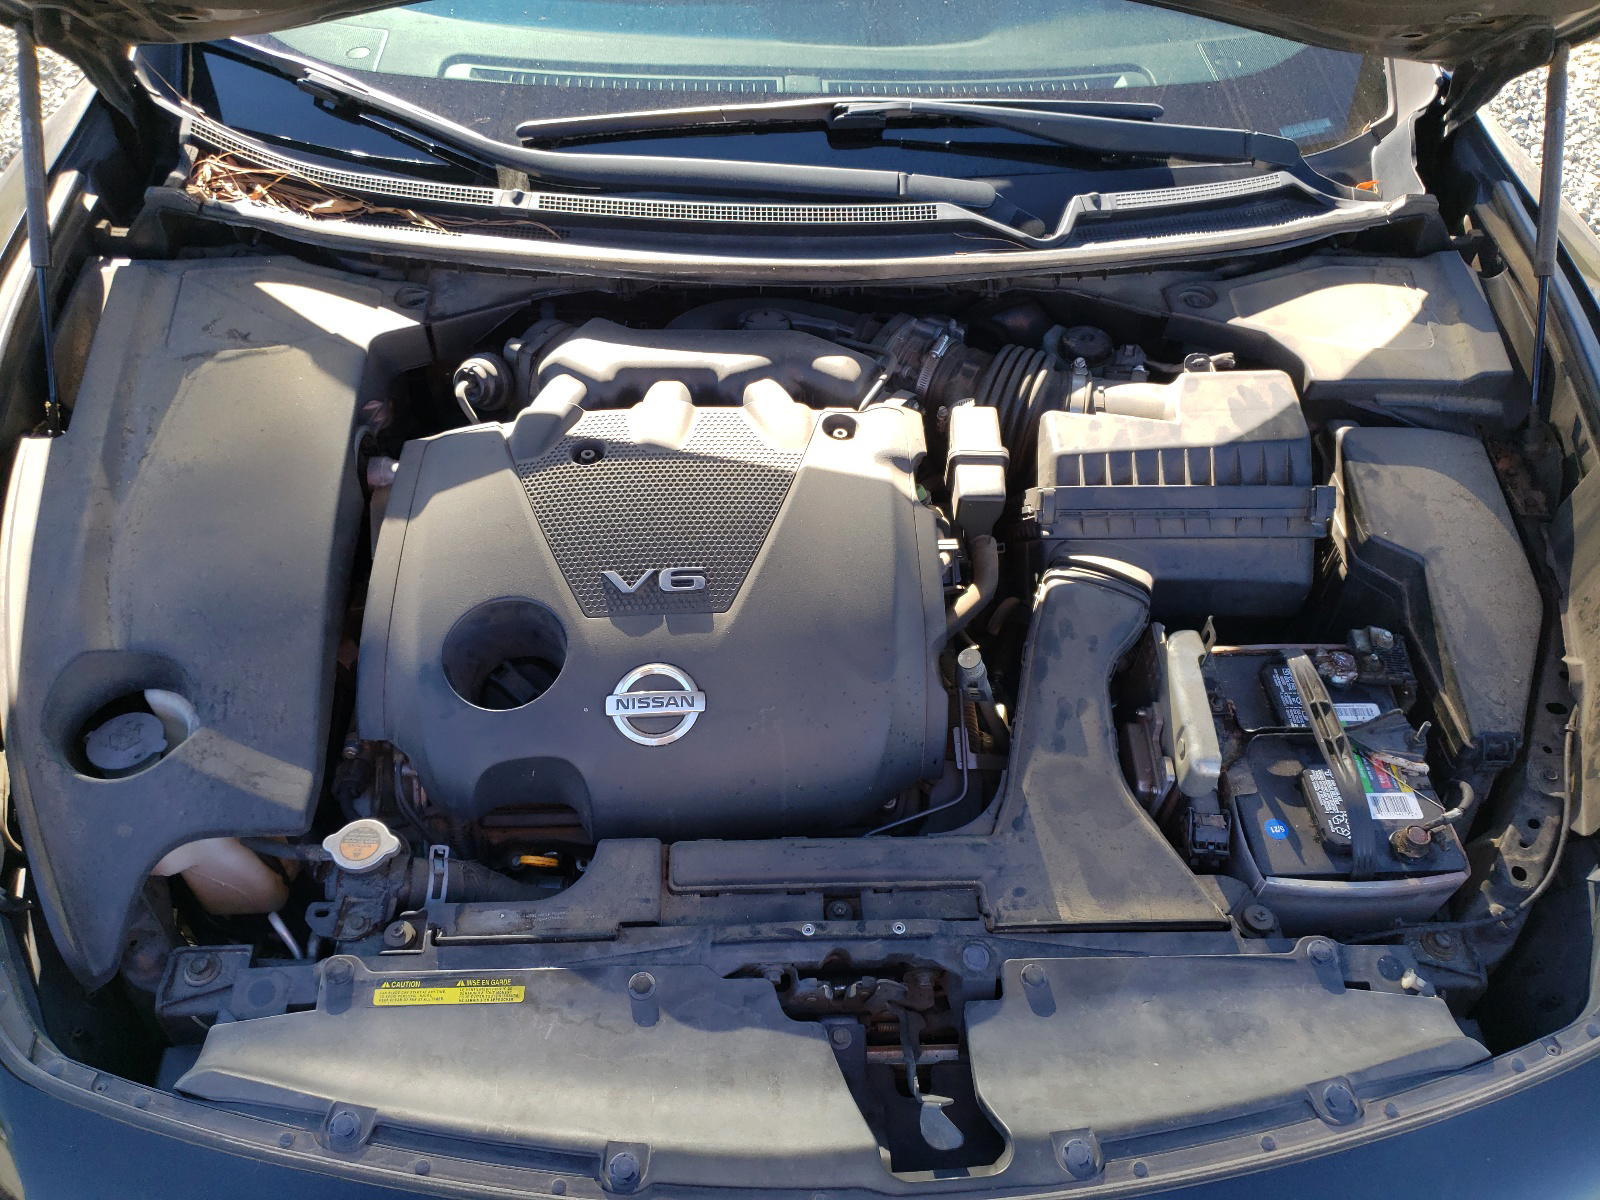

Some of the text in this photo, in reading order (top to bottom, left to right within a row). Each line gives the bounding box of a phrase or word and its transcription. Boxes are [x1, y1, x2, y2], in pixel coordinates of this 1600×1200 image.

[602, 567, 706, 593] V6
[615, 695, 695, 710] NISSAN
[391, 980, 421, 988] CAUTION
[490, 978, 512, 986] GARDE
